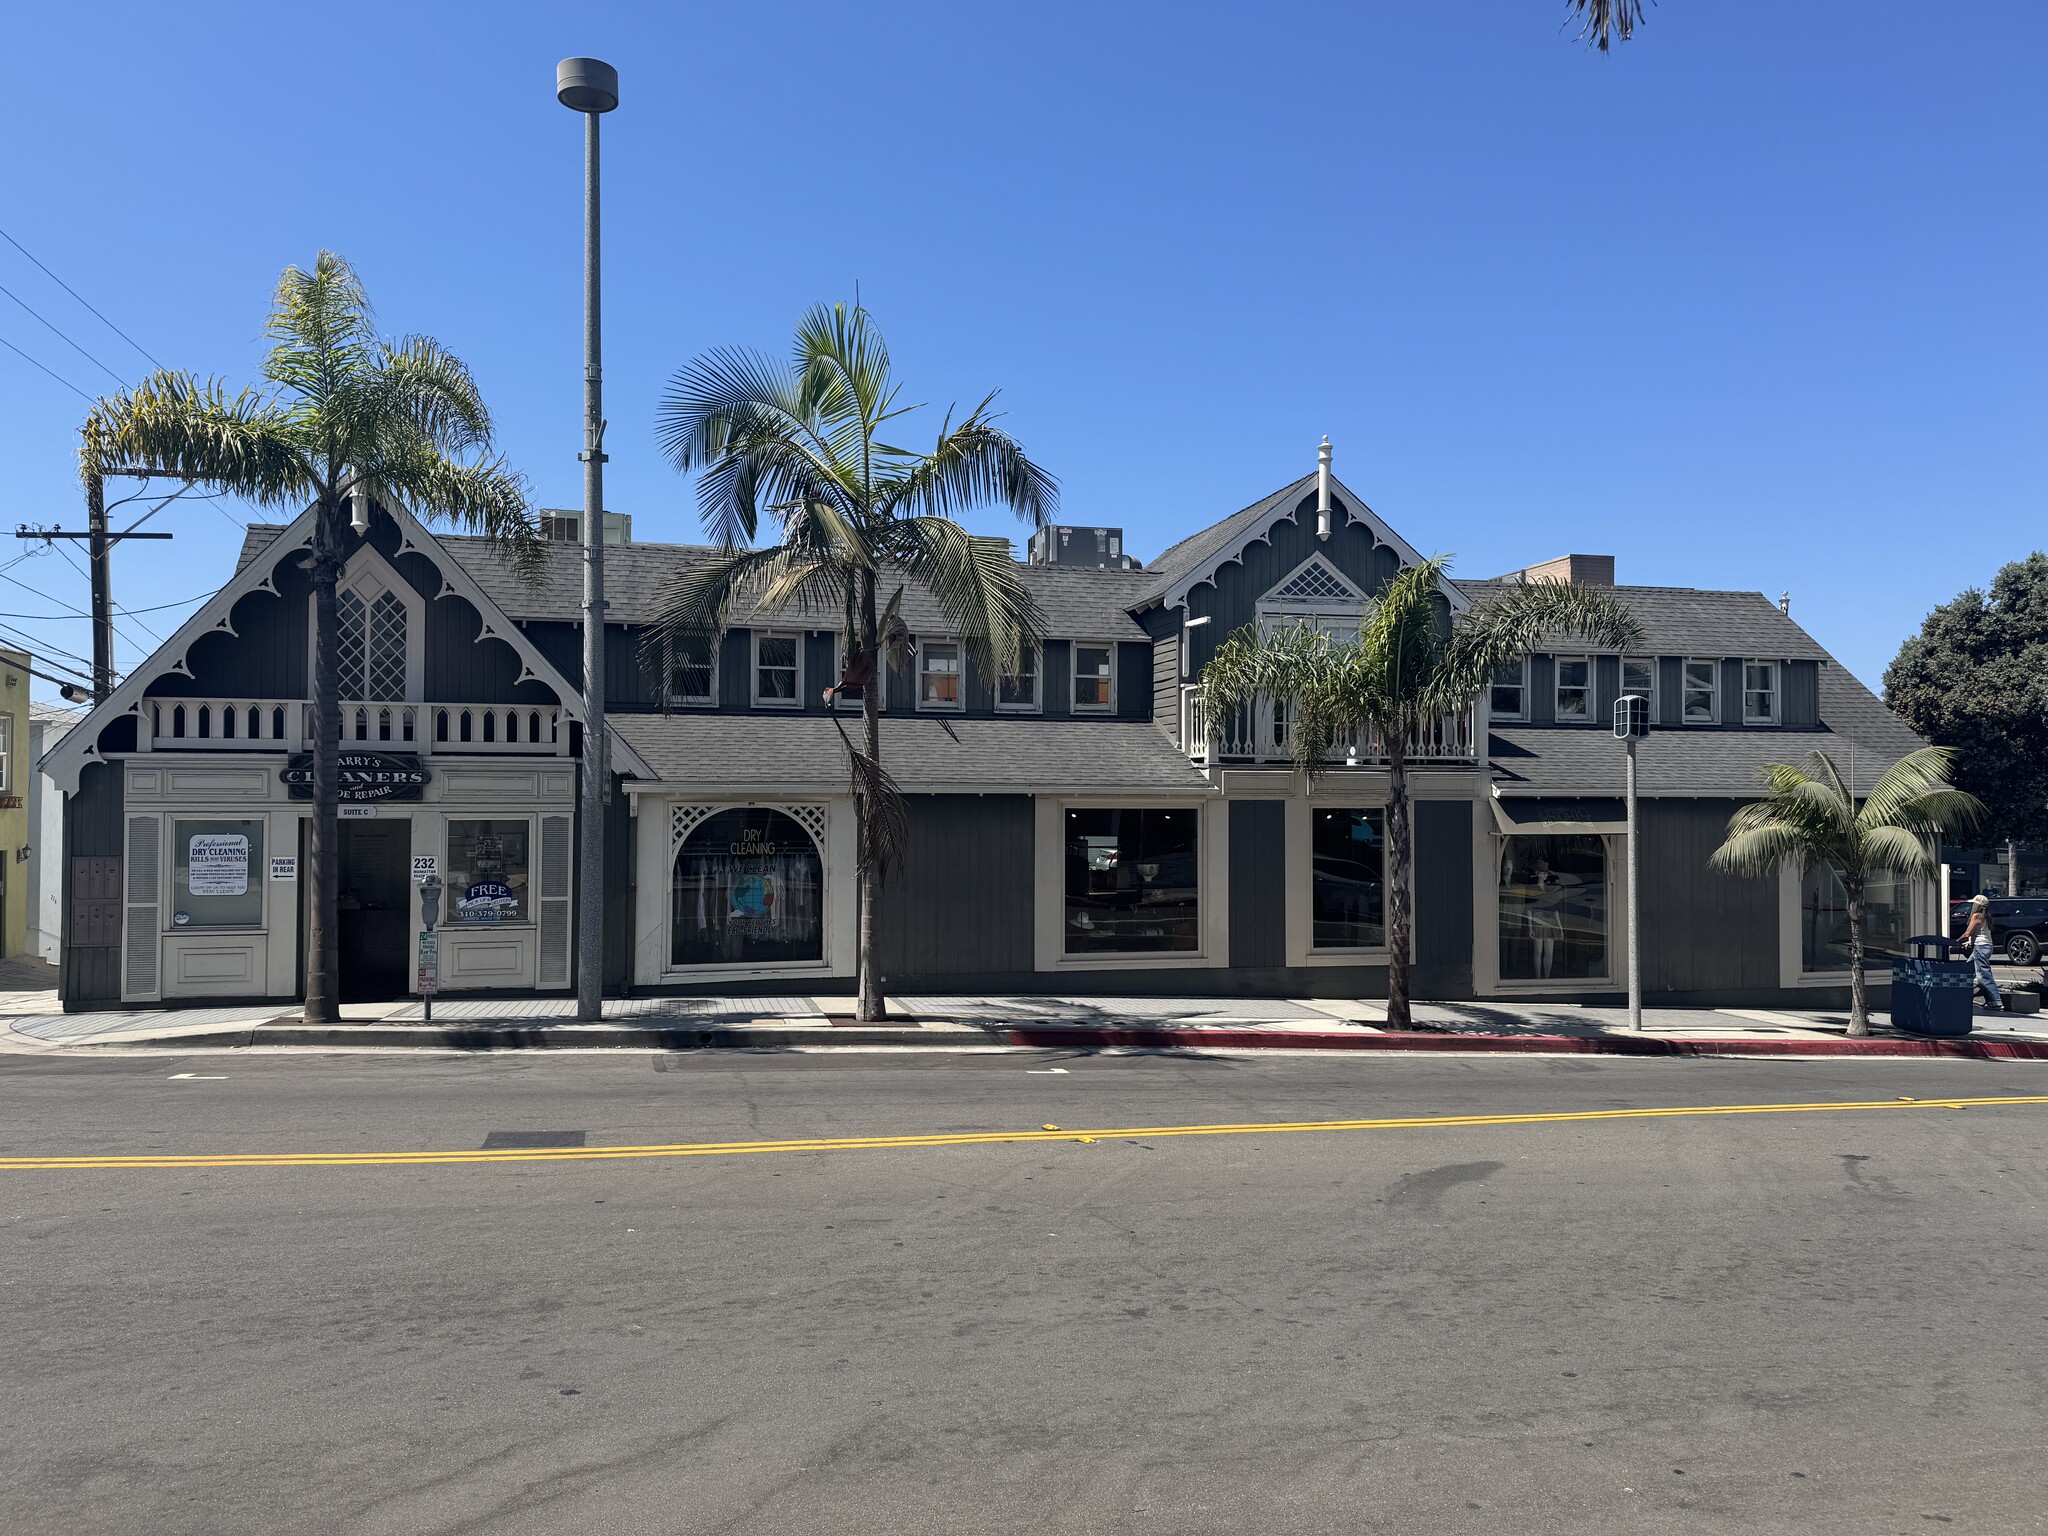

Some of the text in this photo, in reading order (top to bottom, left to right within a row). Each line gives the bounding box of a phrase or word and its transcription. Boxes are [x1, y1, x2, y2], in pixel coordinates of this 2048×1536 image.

[337, 756, 381, 768] ARRY'S
[286, 771, 423, 784] CLANERS
[354, 785, 393, 800] REPAIR
[743, 829, 762, 842] DRY
[195, 838, 243, 849] Professional
[730, 842, 776, 855] CLEANING
[192, 848, 246, 856] DRY CLEANING
[271, 858, 296, 866] PARKING
[413, 857, 435, 869] 232
[471, 885, 507, 897] FREE
